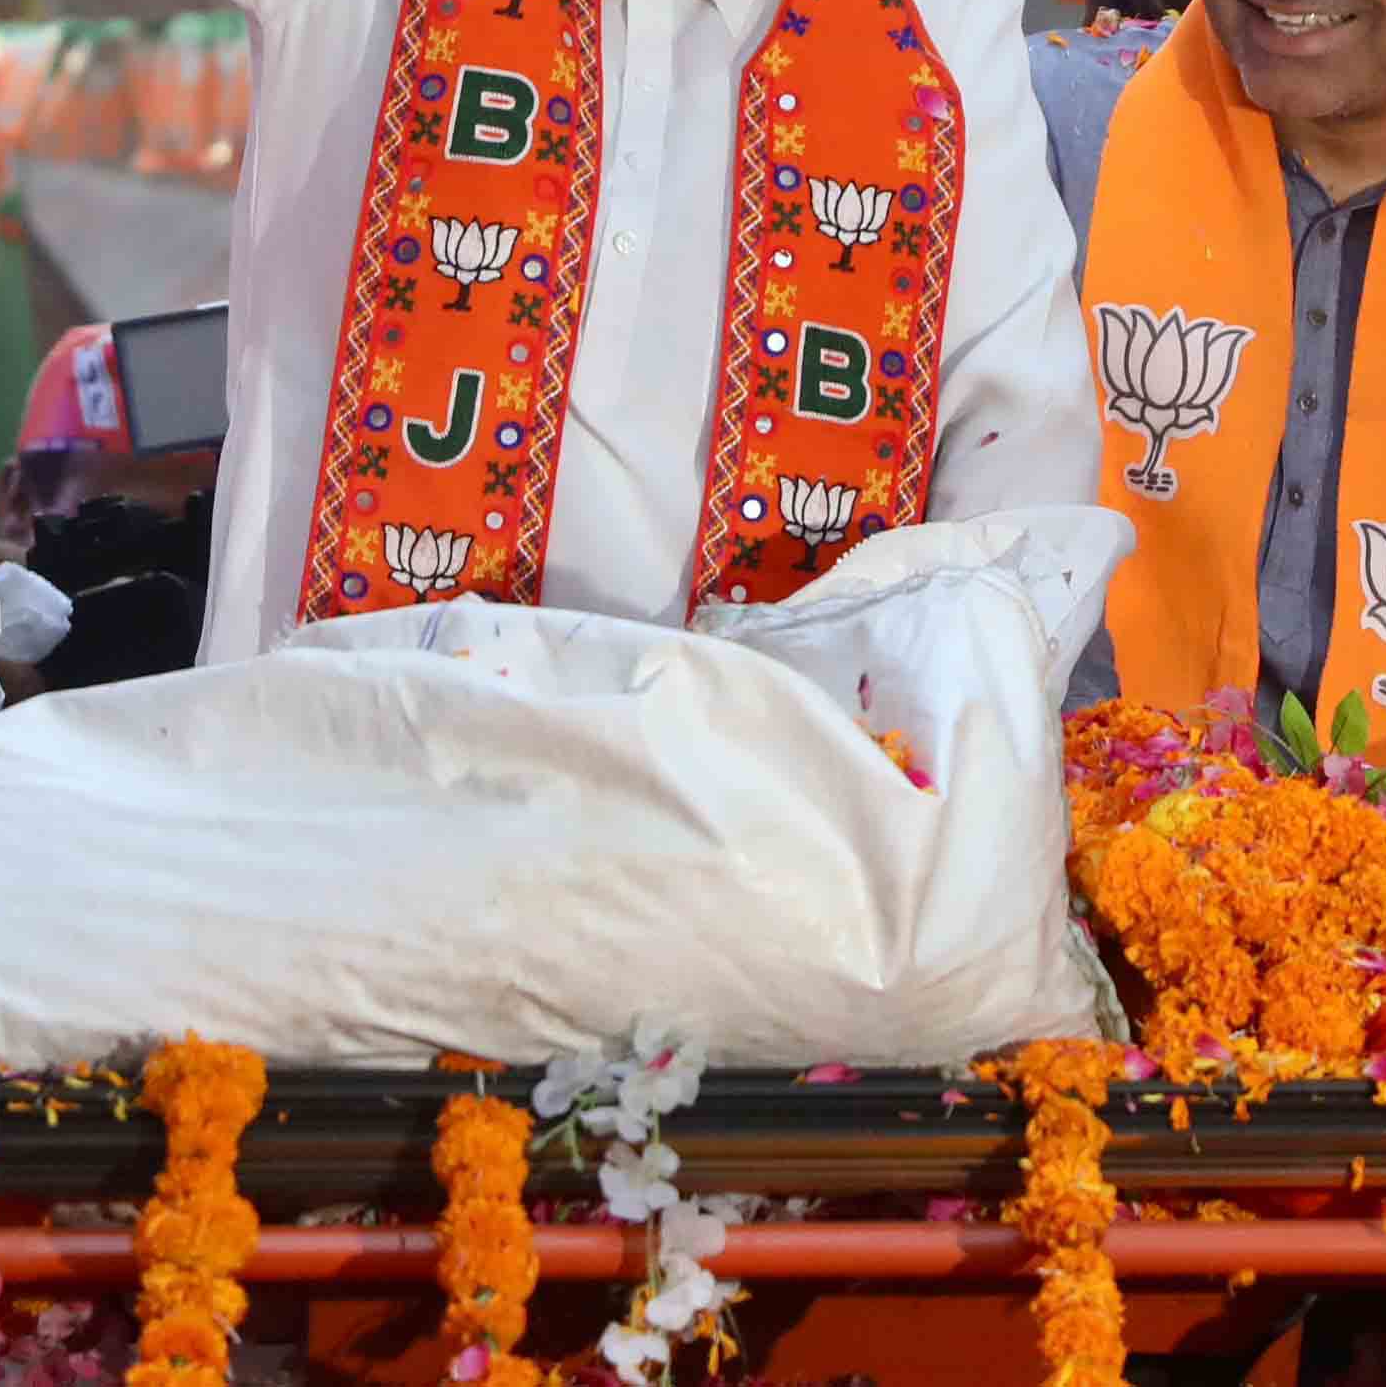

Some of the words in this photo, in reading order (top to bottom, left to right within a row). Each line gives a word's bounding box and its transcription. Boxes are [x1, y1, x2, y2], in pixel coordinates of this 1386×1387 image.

[446, 66, 539, 164] B
[403, 368, 485, 467] J
[795, 321, 871, 425] B
